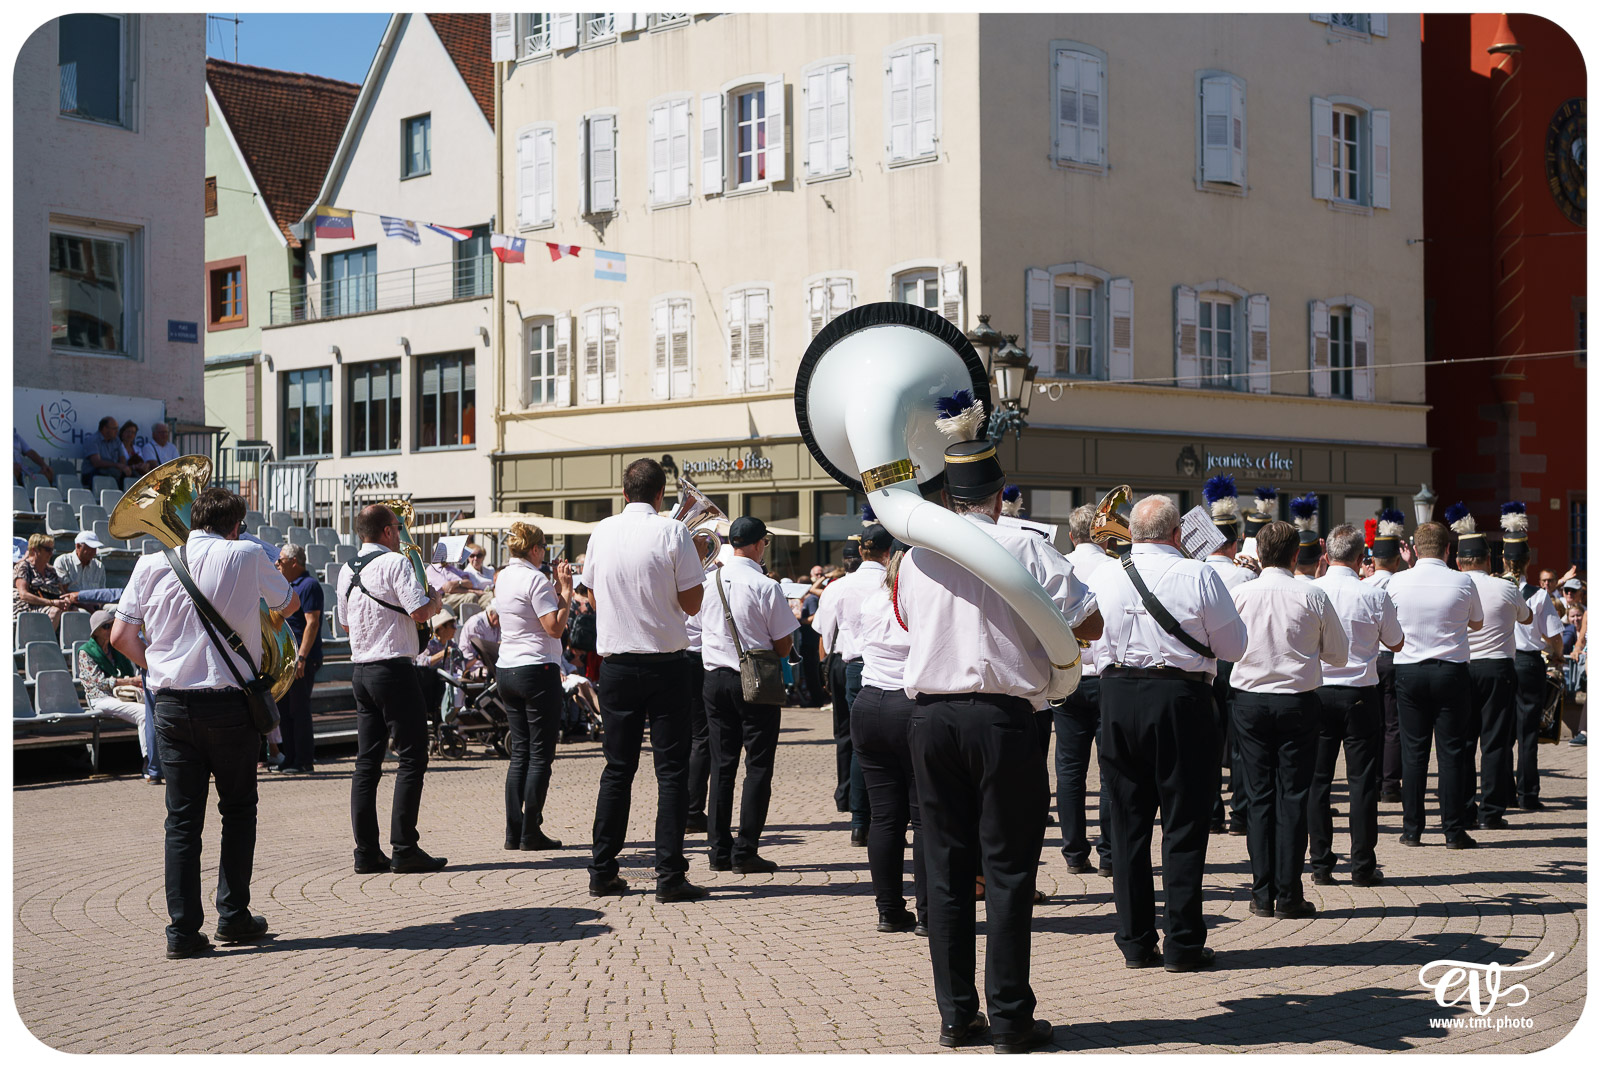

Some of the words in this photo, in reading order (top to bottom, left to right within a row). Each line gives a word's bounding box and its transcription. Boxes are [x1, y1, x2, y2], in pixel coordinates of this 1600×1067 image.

[731, 451, 773, 471] coffee
[1206, 451, 1252, 471] jeanie's
[1255, 451, 1293, 470] coffee
